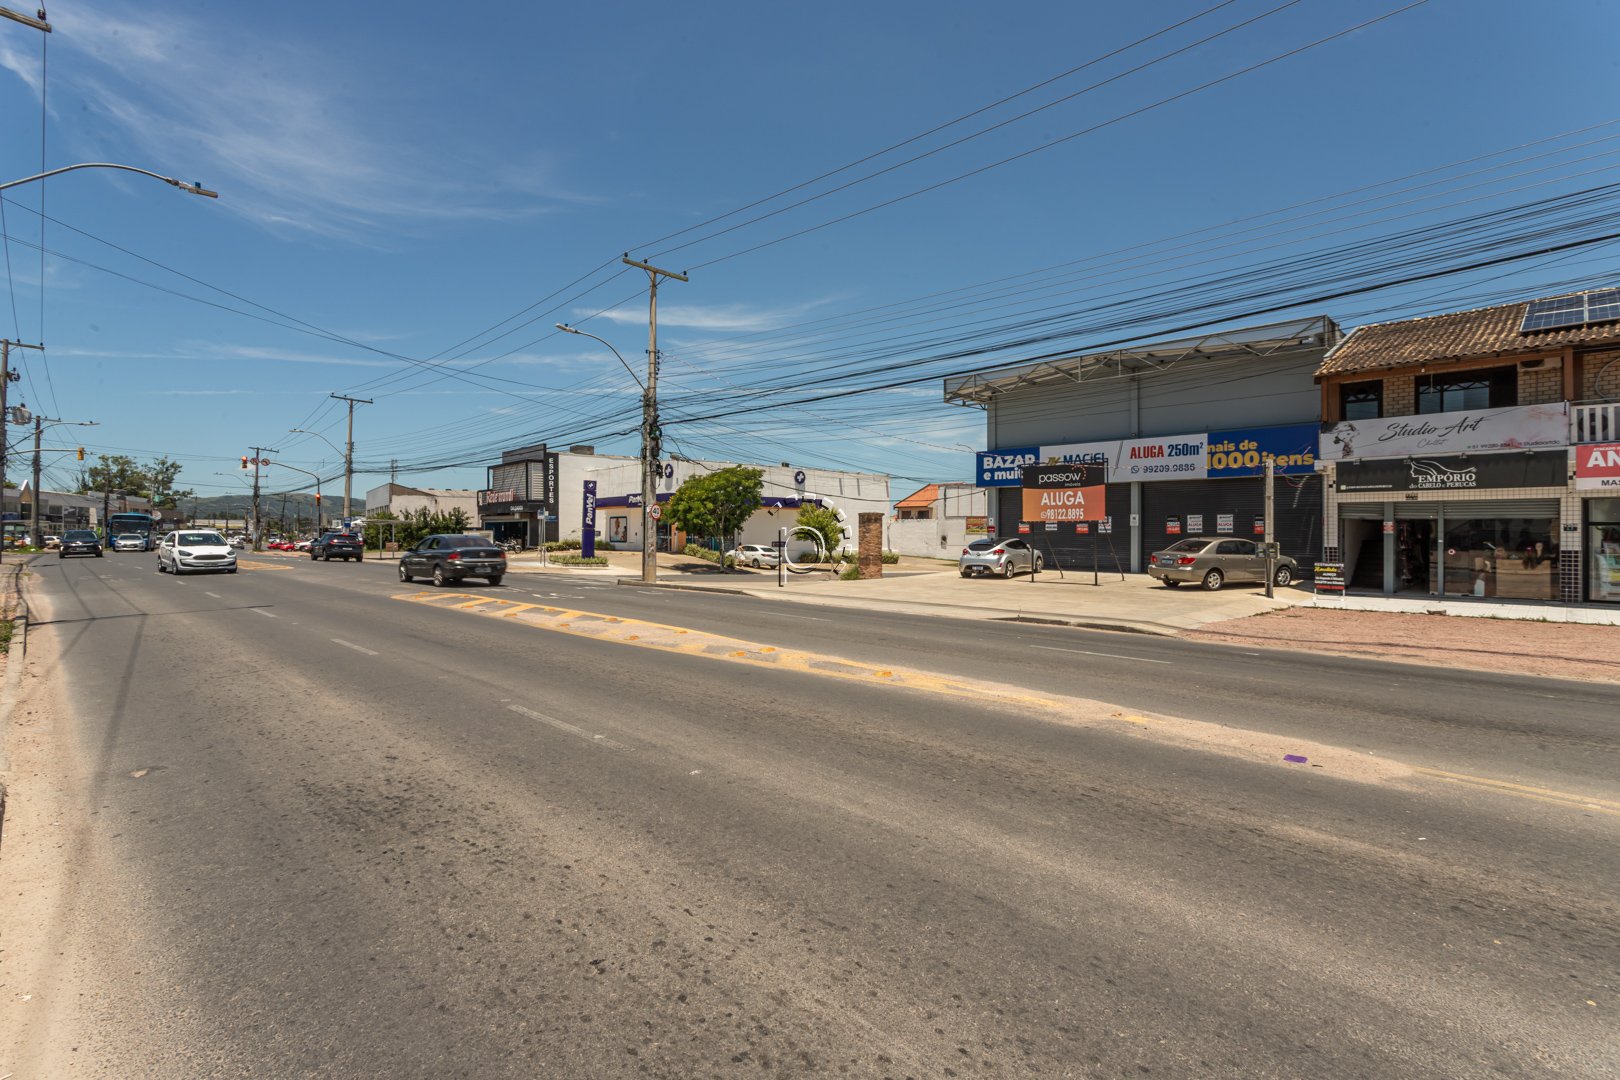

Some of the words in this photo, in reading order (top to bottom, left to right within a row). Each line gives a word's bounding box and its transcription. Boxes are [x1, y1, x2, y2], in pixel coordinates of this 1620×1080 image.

[1378, 421, 1438, 441] Studio
[1438, 416, 1492, 437] Art
[1239, 439, 1258, 451] de
[1130, 445, 1164, 460] ALUGA
[983, 472, 992, 480] e
[1038, 472, 1081, 484] passow
[1418, 472, 1476, 483] EMPÓRIO
[1041, 491, 1085, 506] ALUGA
[1047, 508, 1084, 519] 98122.8895
